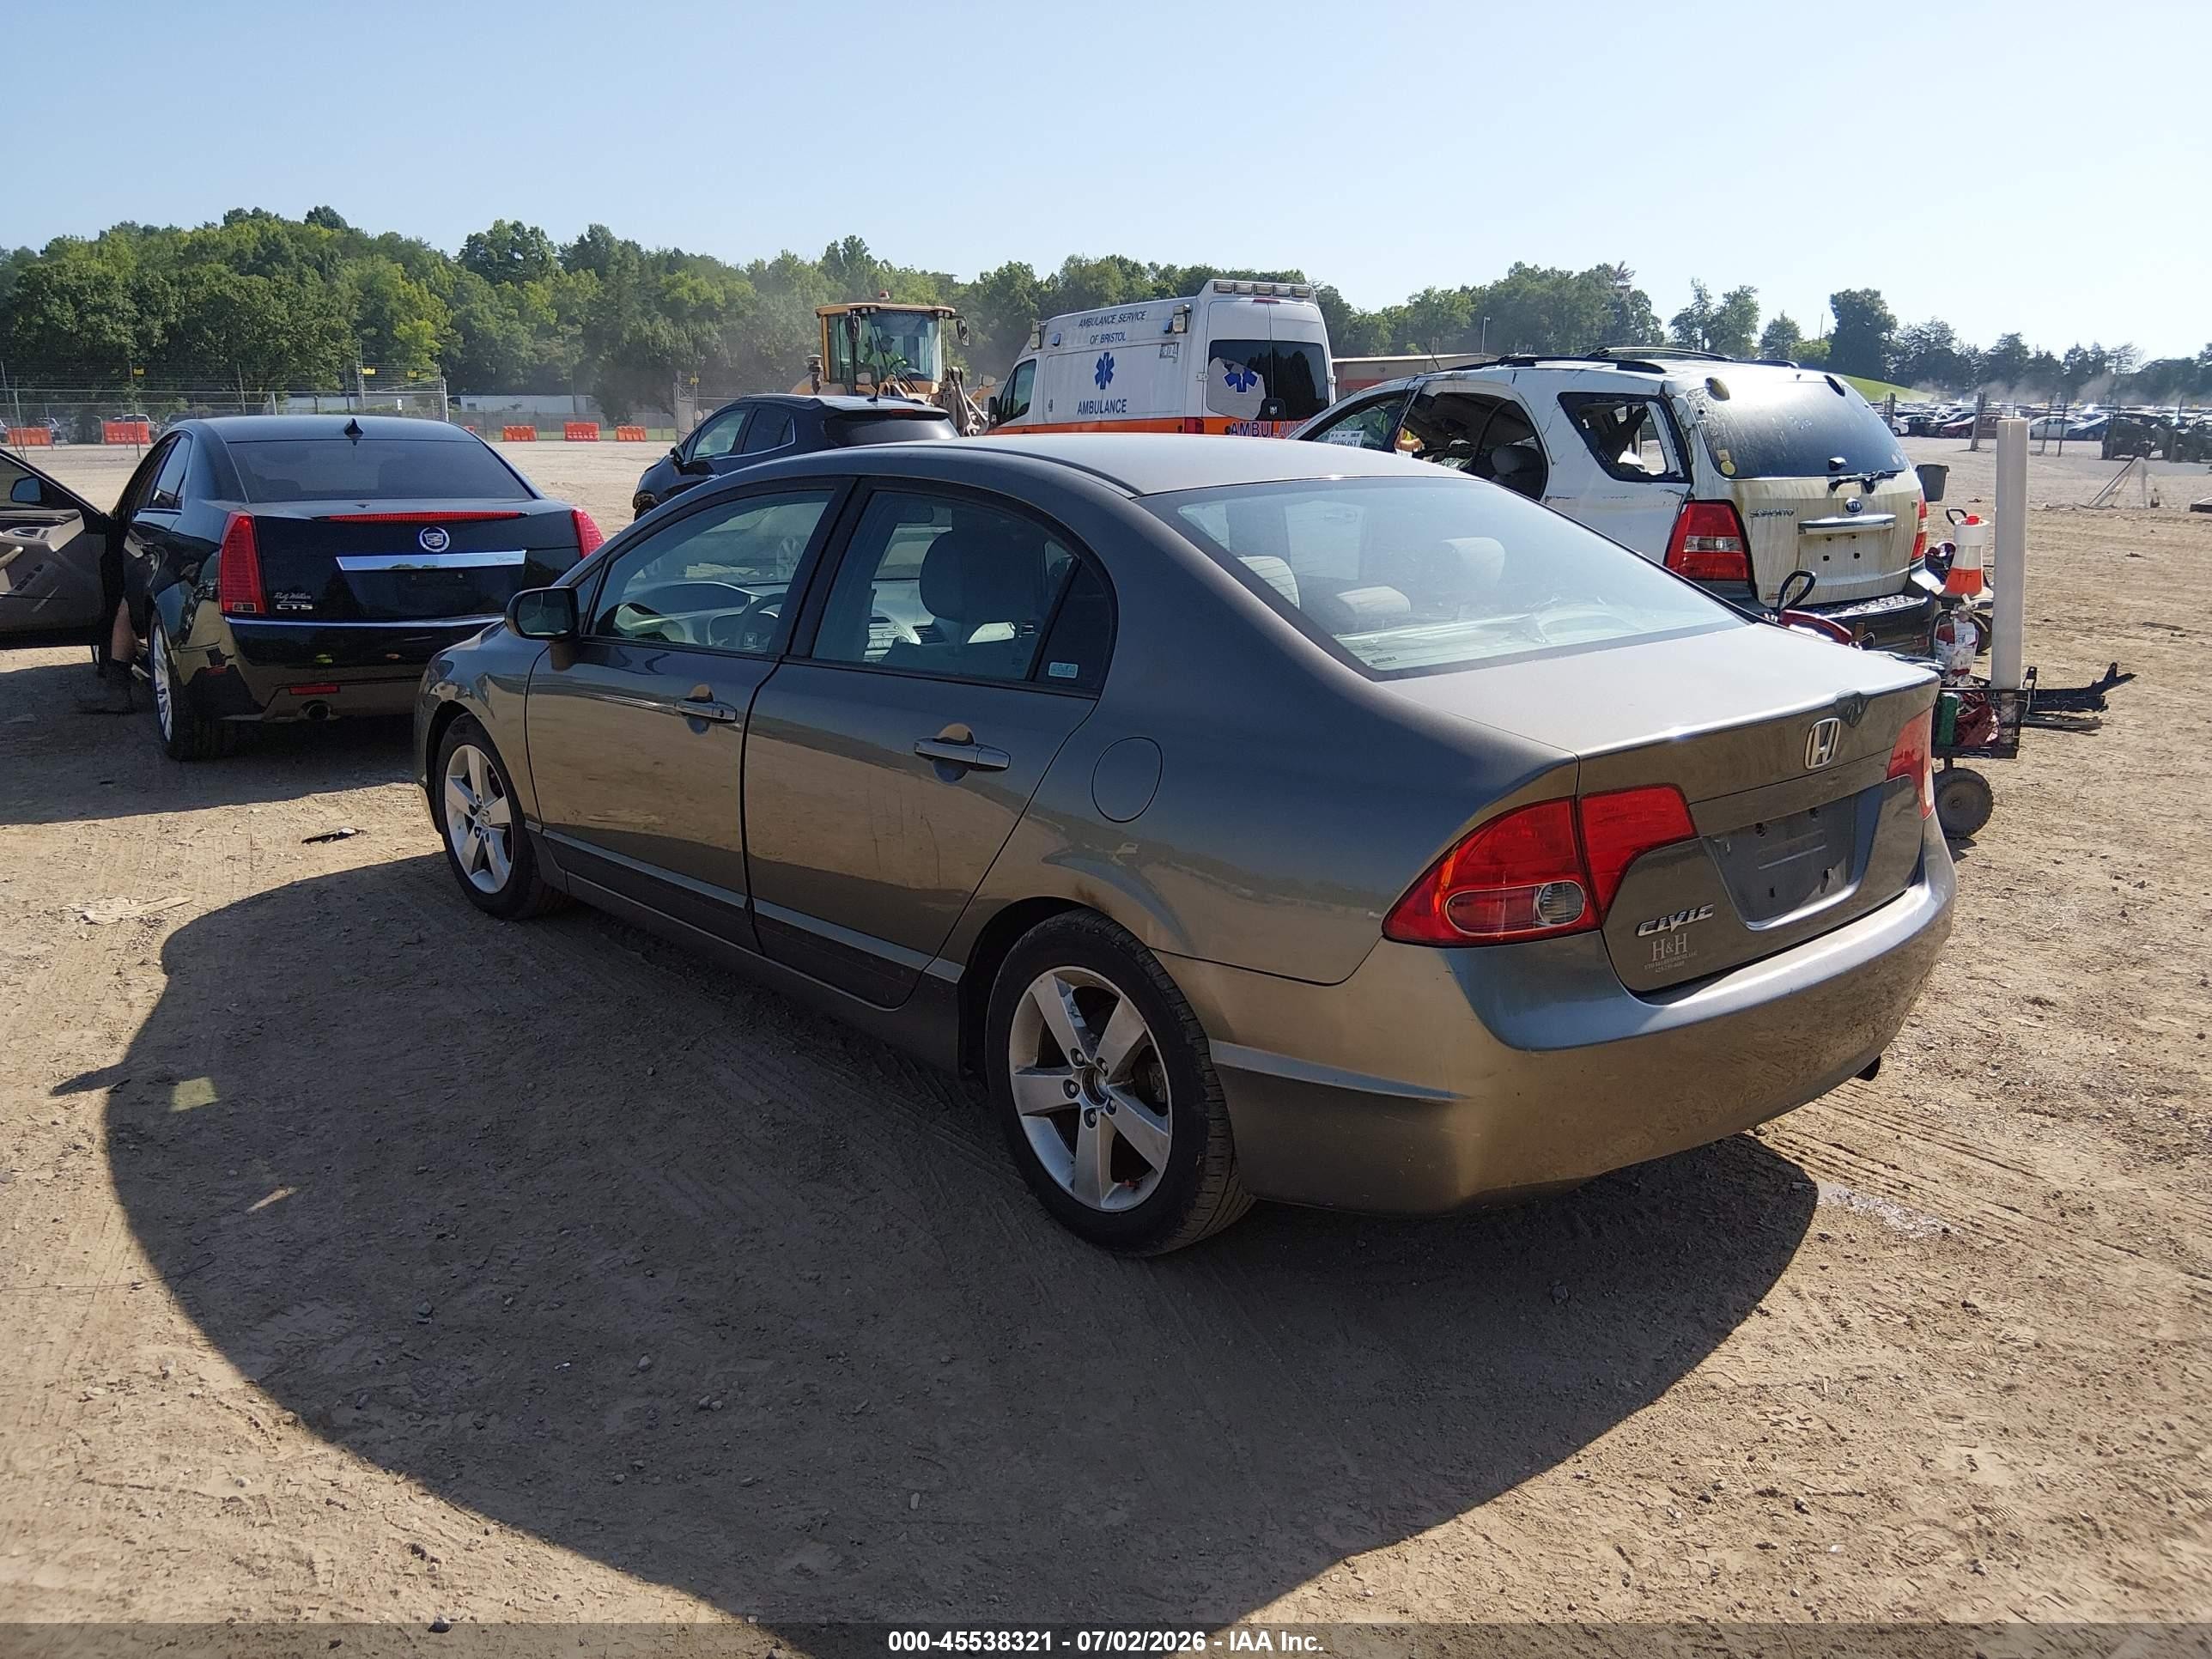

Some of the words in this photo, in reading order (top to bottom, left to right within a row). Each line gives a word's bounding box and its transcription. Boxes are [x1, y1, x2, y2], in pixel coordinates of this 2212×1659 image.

[1079, 313, 1116, 329] AMBULANCE
[1118, 310, 1147, 323] SERVICE
[1090, 335, 1098, 344] OF
[1100, 331, 1127, 343] BRISTOL
[1077, 398, 1127, 415] AMBULANCE
[1230, 420, 1305, 439] AMBULANC
[1636, 903, 1715, 937] CIVIC
[1651, 933, 1688, 962] H&H
